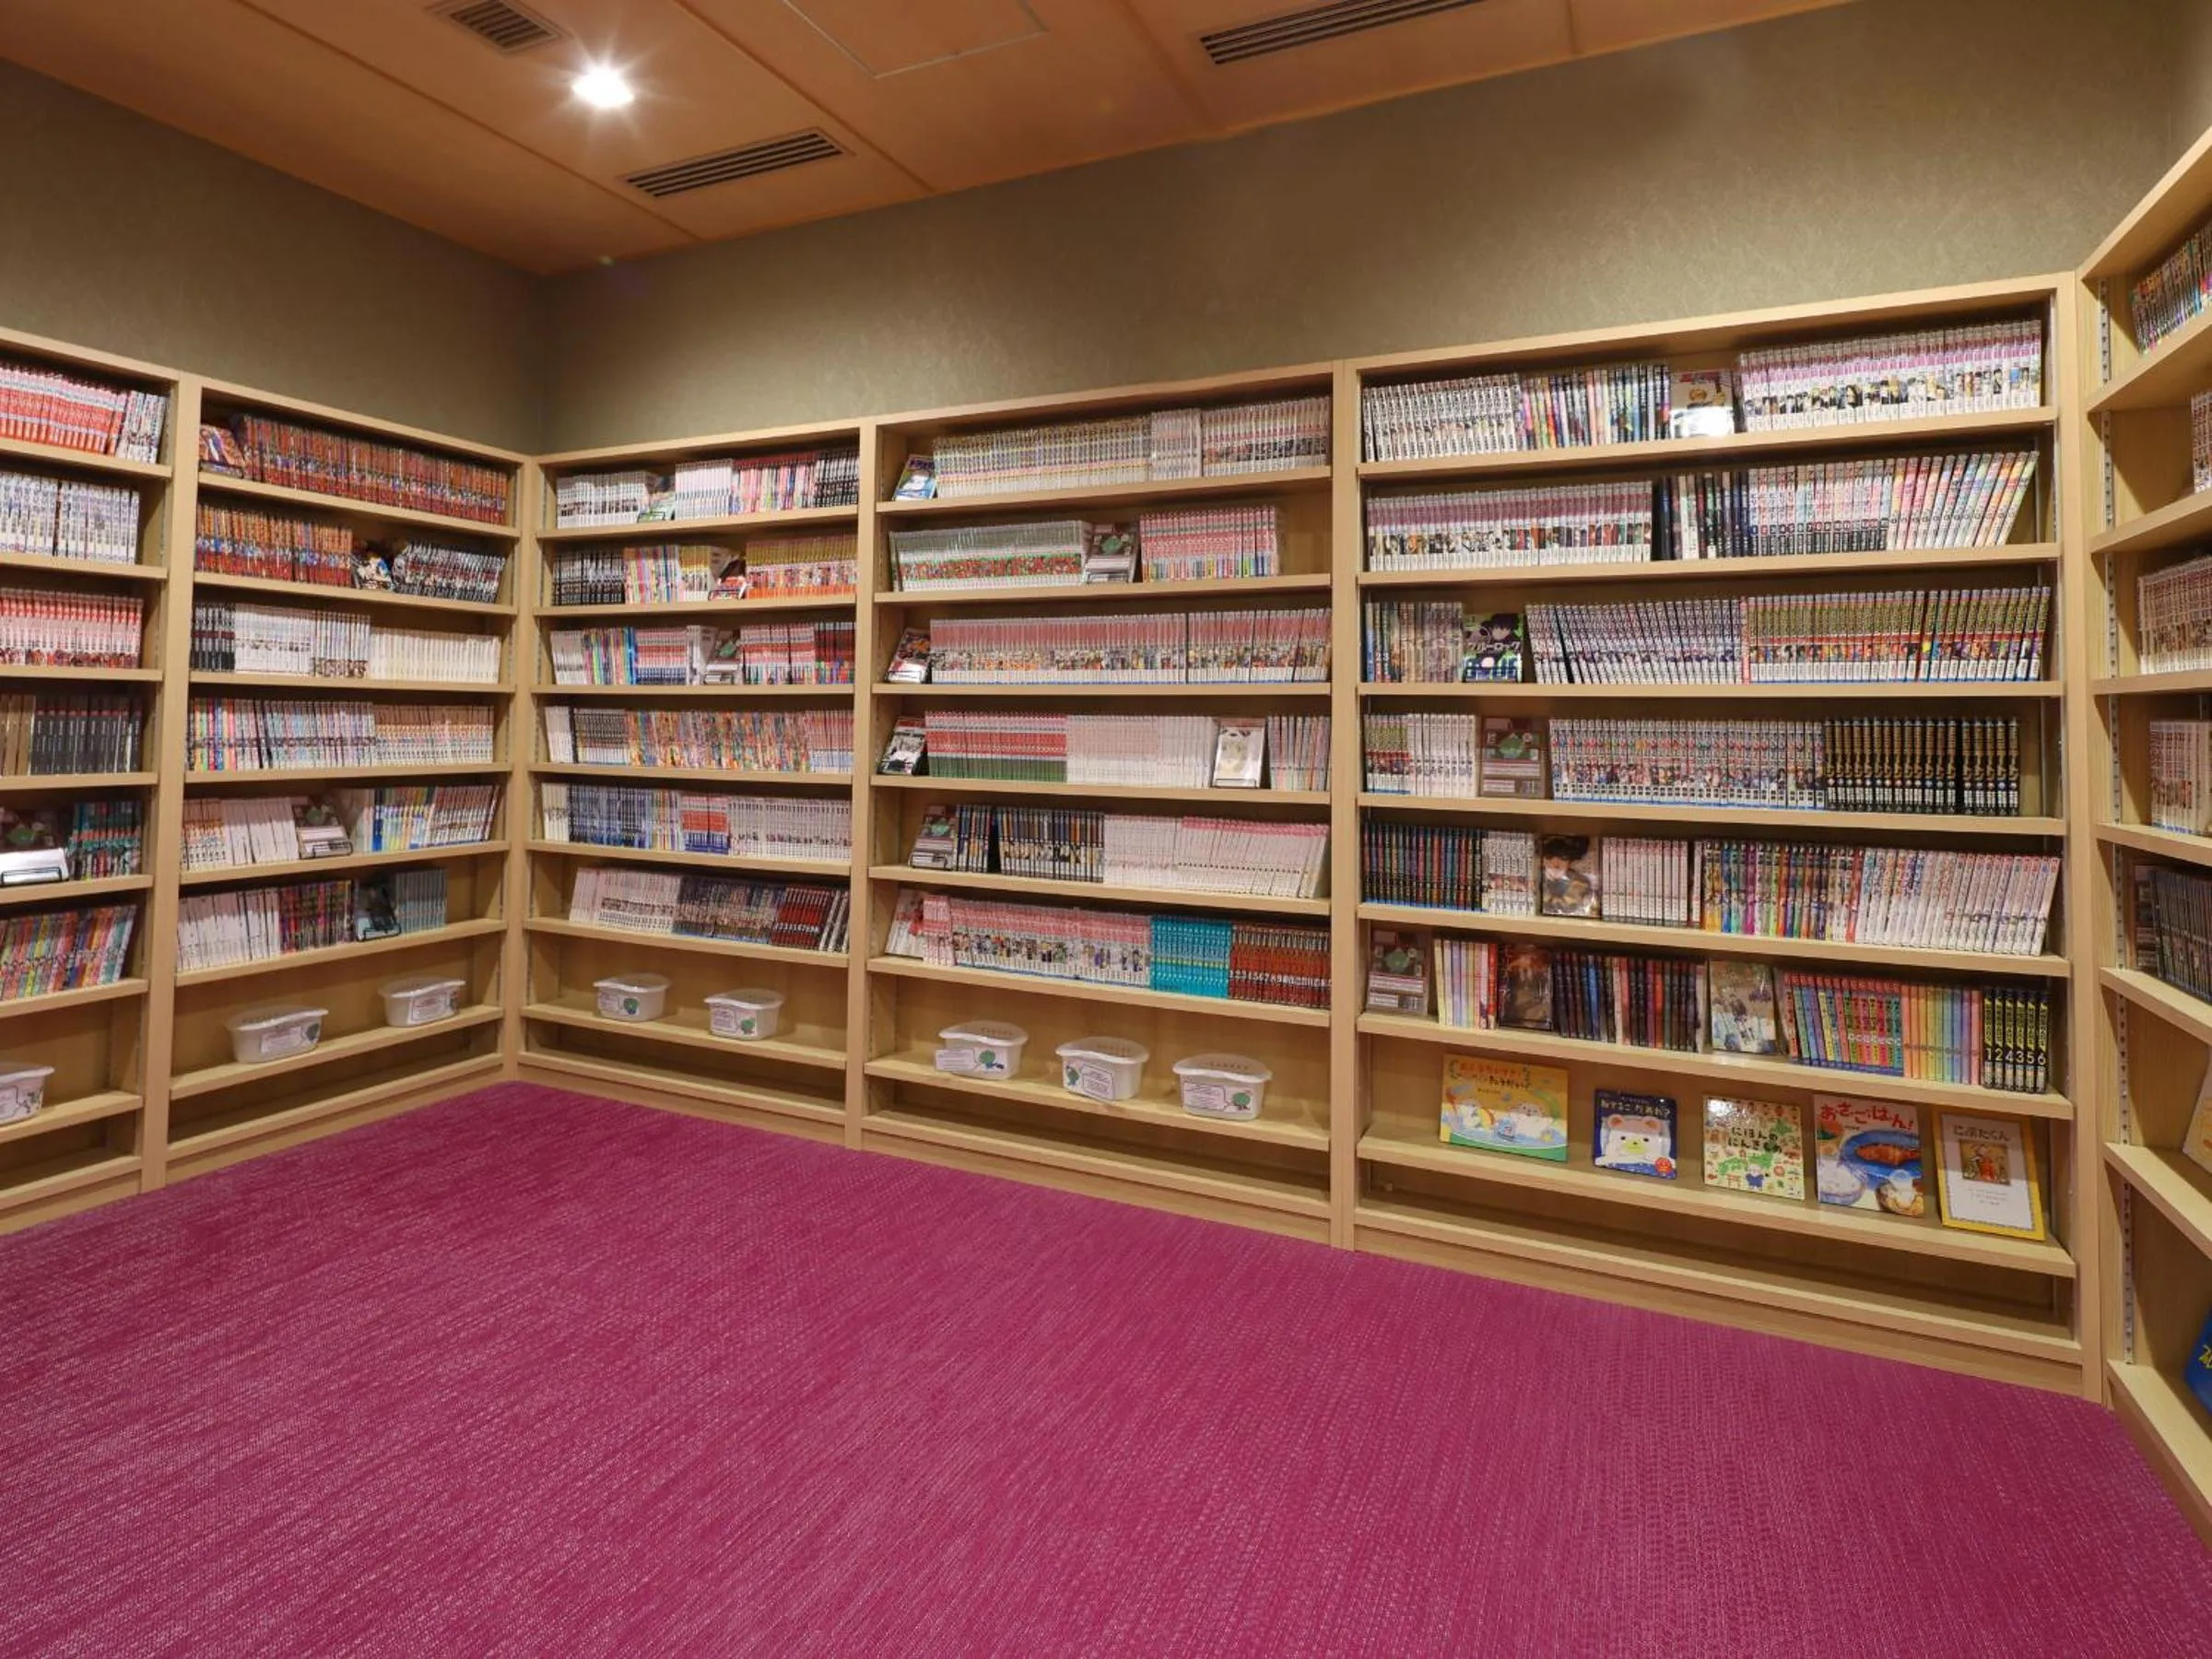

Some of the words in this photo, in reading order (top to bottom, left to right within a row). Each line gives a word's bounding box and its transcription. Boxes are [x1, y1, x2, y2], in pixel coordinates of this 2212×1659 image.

[1986, 1048, 1992, 1061] 1
[1994, 1048, 2004, 1062] 2
[2006, 1051, 2014, 1063] 4
[2016, 1051, 2025, 1064] 3
[2027, 1051, 2035, 1065] 5
[2038, 1053, 2046, 1065] 6
[1732, 1126, 1778, 1141] にほんの
